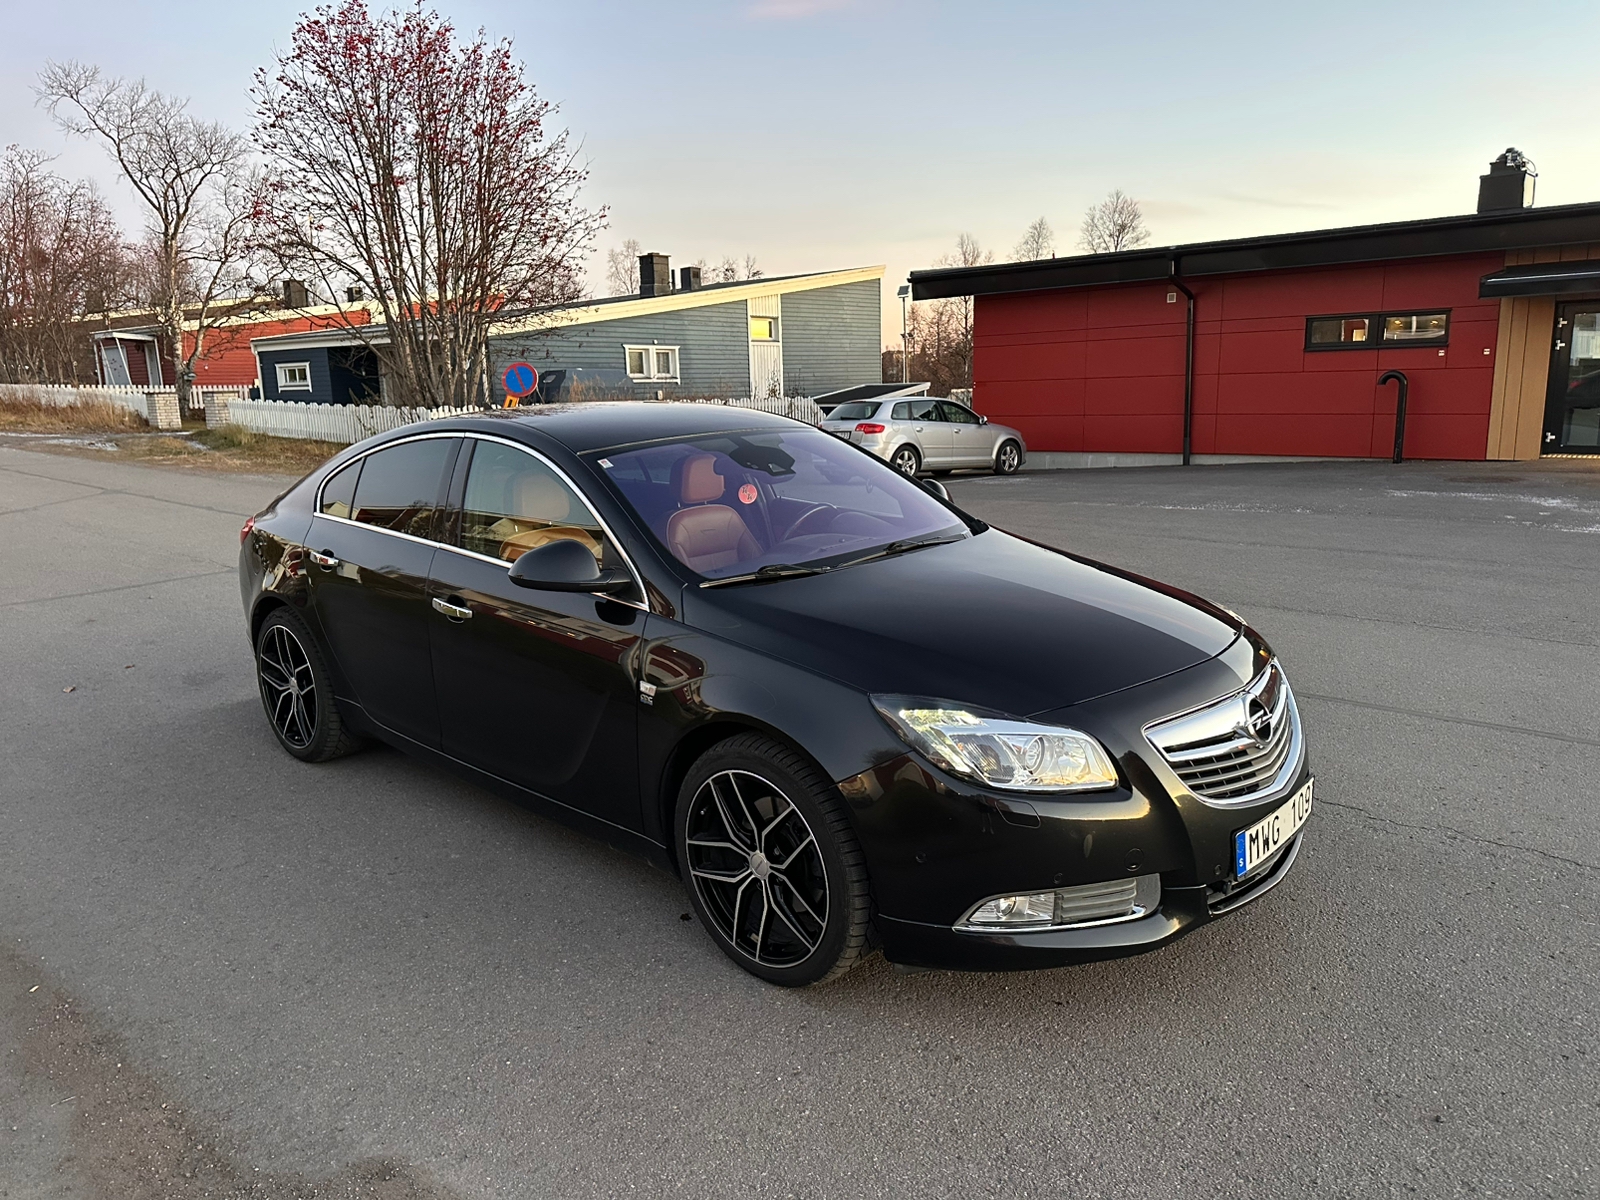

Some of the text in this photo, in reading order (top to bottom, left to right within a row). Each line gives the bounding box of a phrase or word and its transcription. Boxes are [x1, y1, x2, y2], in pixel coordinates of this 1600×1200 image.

[1248, 785, 1311, 864] MWG 109
[1239, 857, 1244, 867] S
